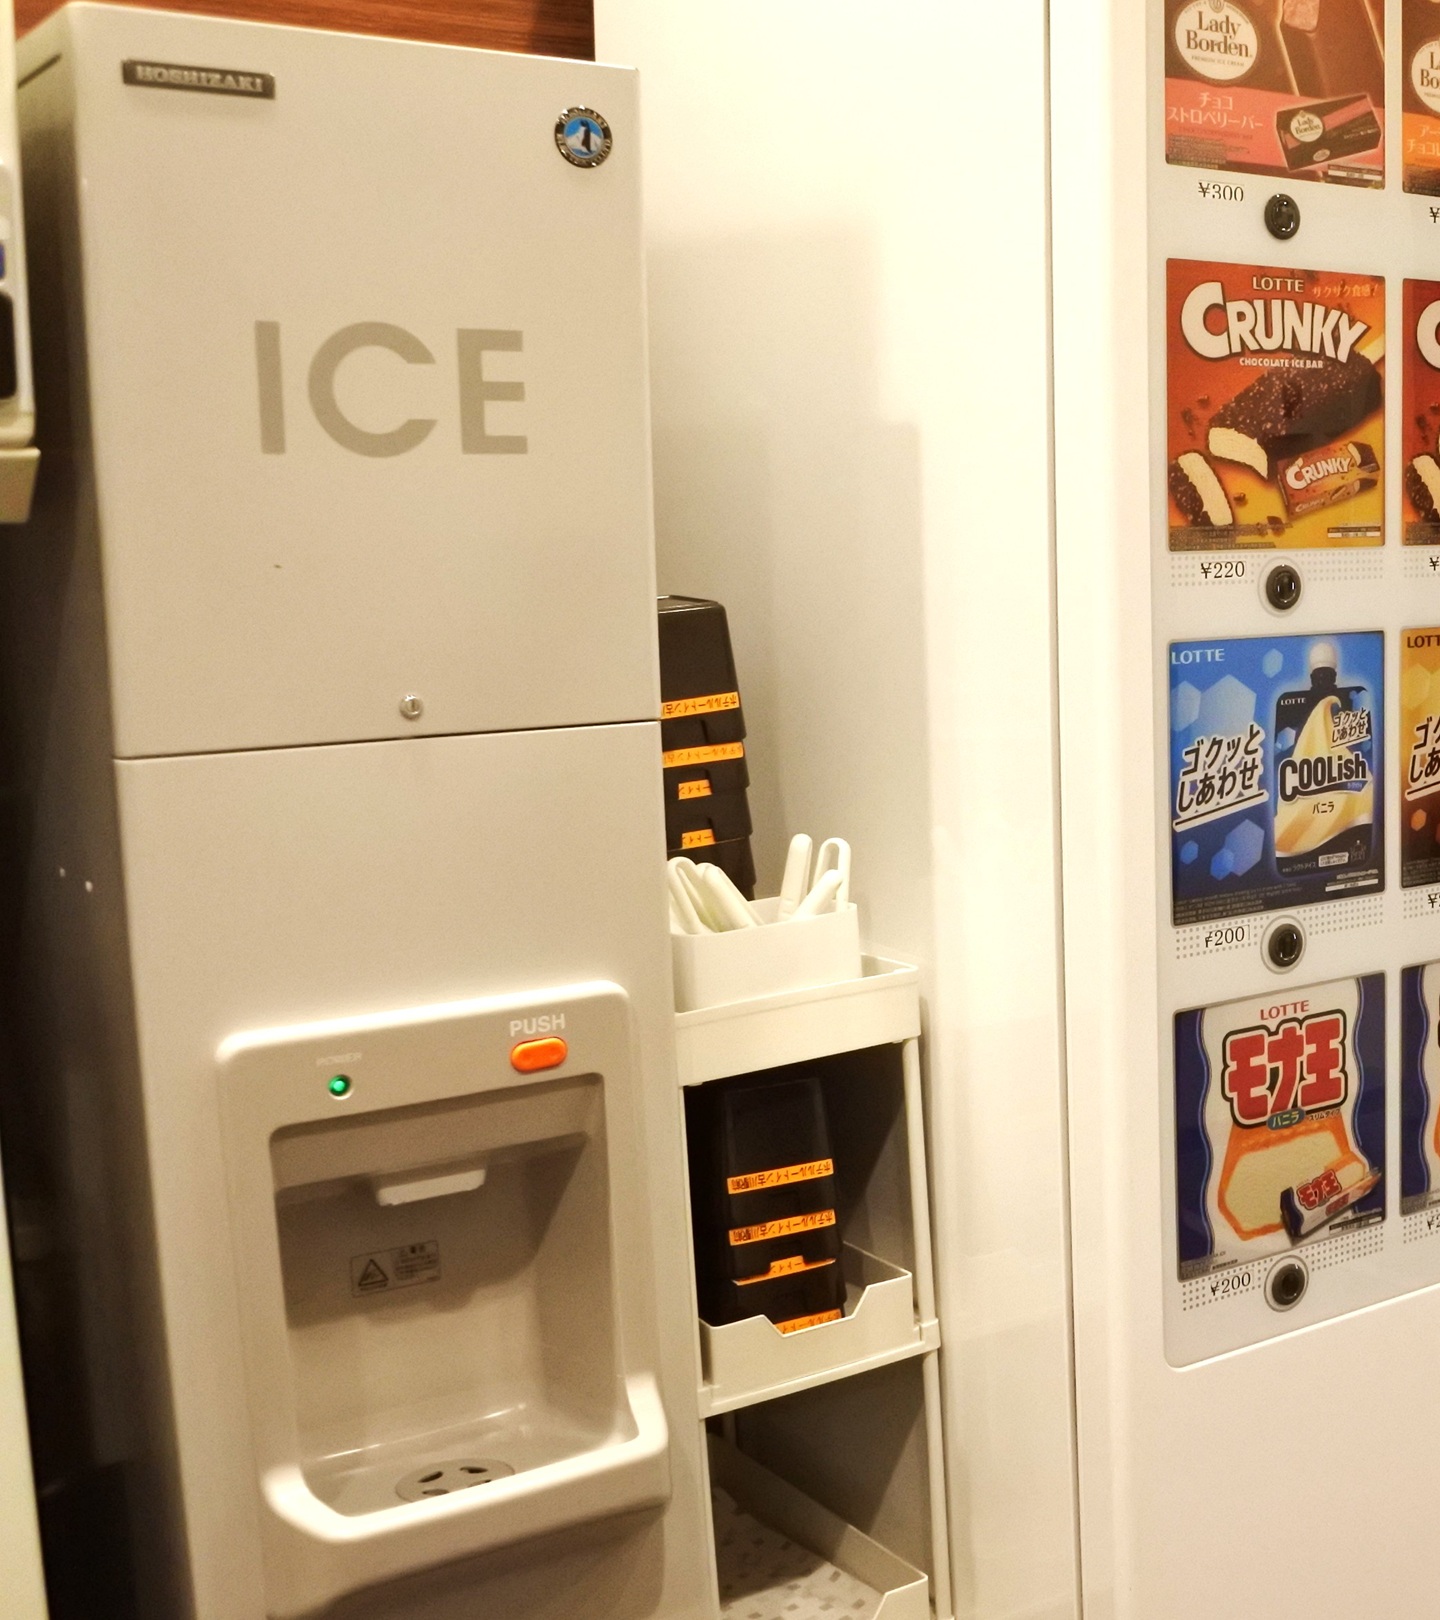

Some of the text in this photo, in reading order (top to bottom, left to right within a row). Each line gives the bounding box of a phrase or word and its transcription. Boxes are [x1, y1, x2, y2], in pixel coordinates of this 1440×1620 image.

[1198, 11, 1241, 39] Lady
[1186, 30, 1249, 58] Borden
[136, 65, 263, 92] HOSHIZAKI
[1200, 92, 1233, 110] チョコ
[1167, 107, 1263, 128] ストロベリーバー
[1198, 182, 1243, 201] ¥300
[1253, 277, 1304, 292] LOTTE
[1181, 281, 1368, 363] CRUNKY
[1239, 357, 1323, 369] CHOCOLATE ICE BAR
[254, 320, 529, 458] ICE
[1286, 457, 1351, 490] CRUNKY
[1200, 561, 1244, 579] ¥220
[1171, 649, 1225, 665] LOTTE
[1281, 697, 1306, 705] LOTTE
[1333, 707, 1367, 728] ゴクッと
[1331, 721, 1366, 743] しあわせ
[1182, 724, 1260, 776] ゴクッと
[1178, 758, 1258, 812] しあわせ
[1312, 801, 1335, 814] バニラ
[1260, 1000, 1309, 1021] LOTTE
[510, 1013, 566, 1037] PUSH
[1224, 1012, 1345, 1125] モナ王
[1272, 1111, 1299, 1128] バニラ
[1297, 1169, 1342, 1210] モナ王
[1209, 1272, 1250, 1297] ¥200
